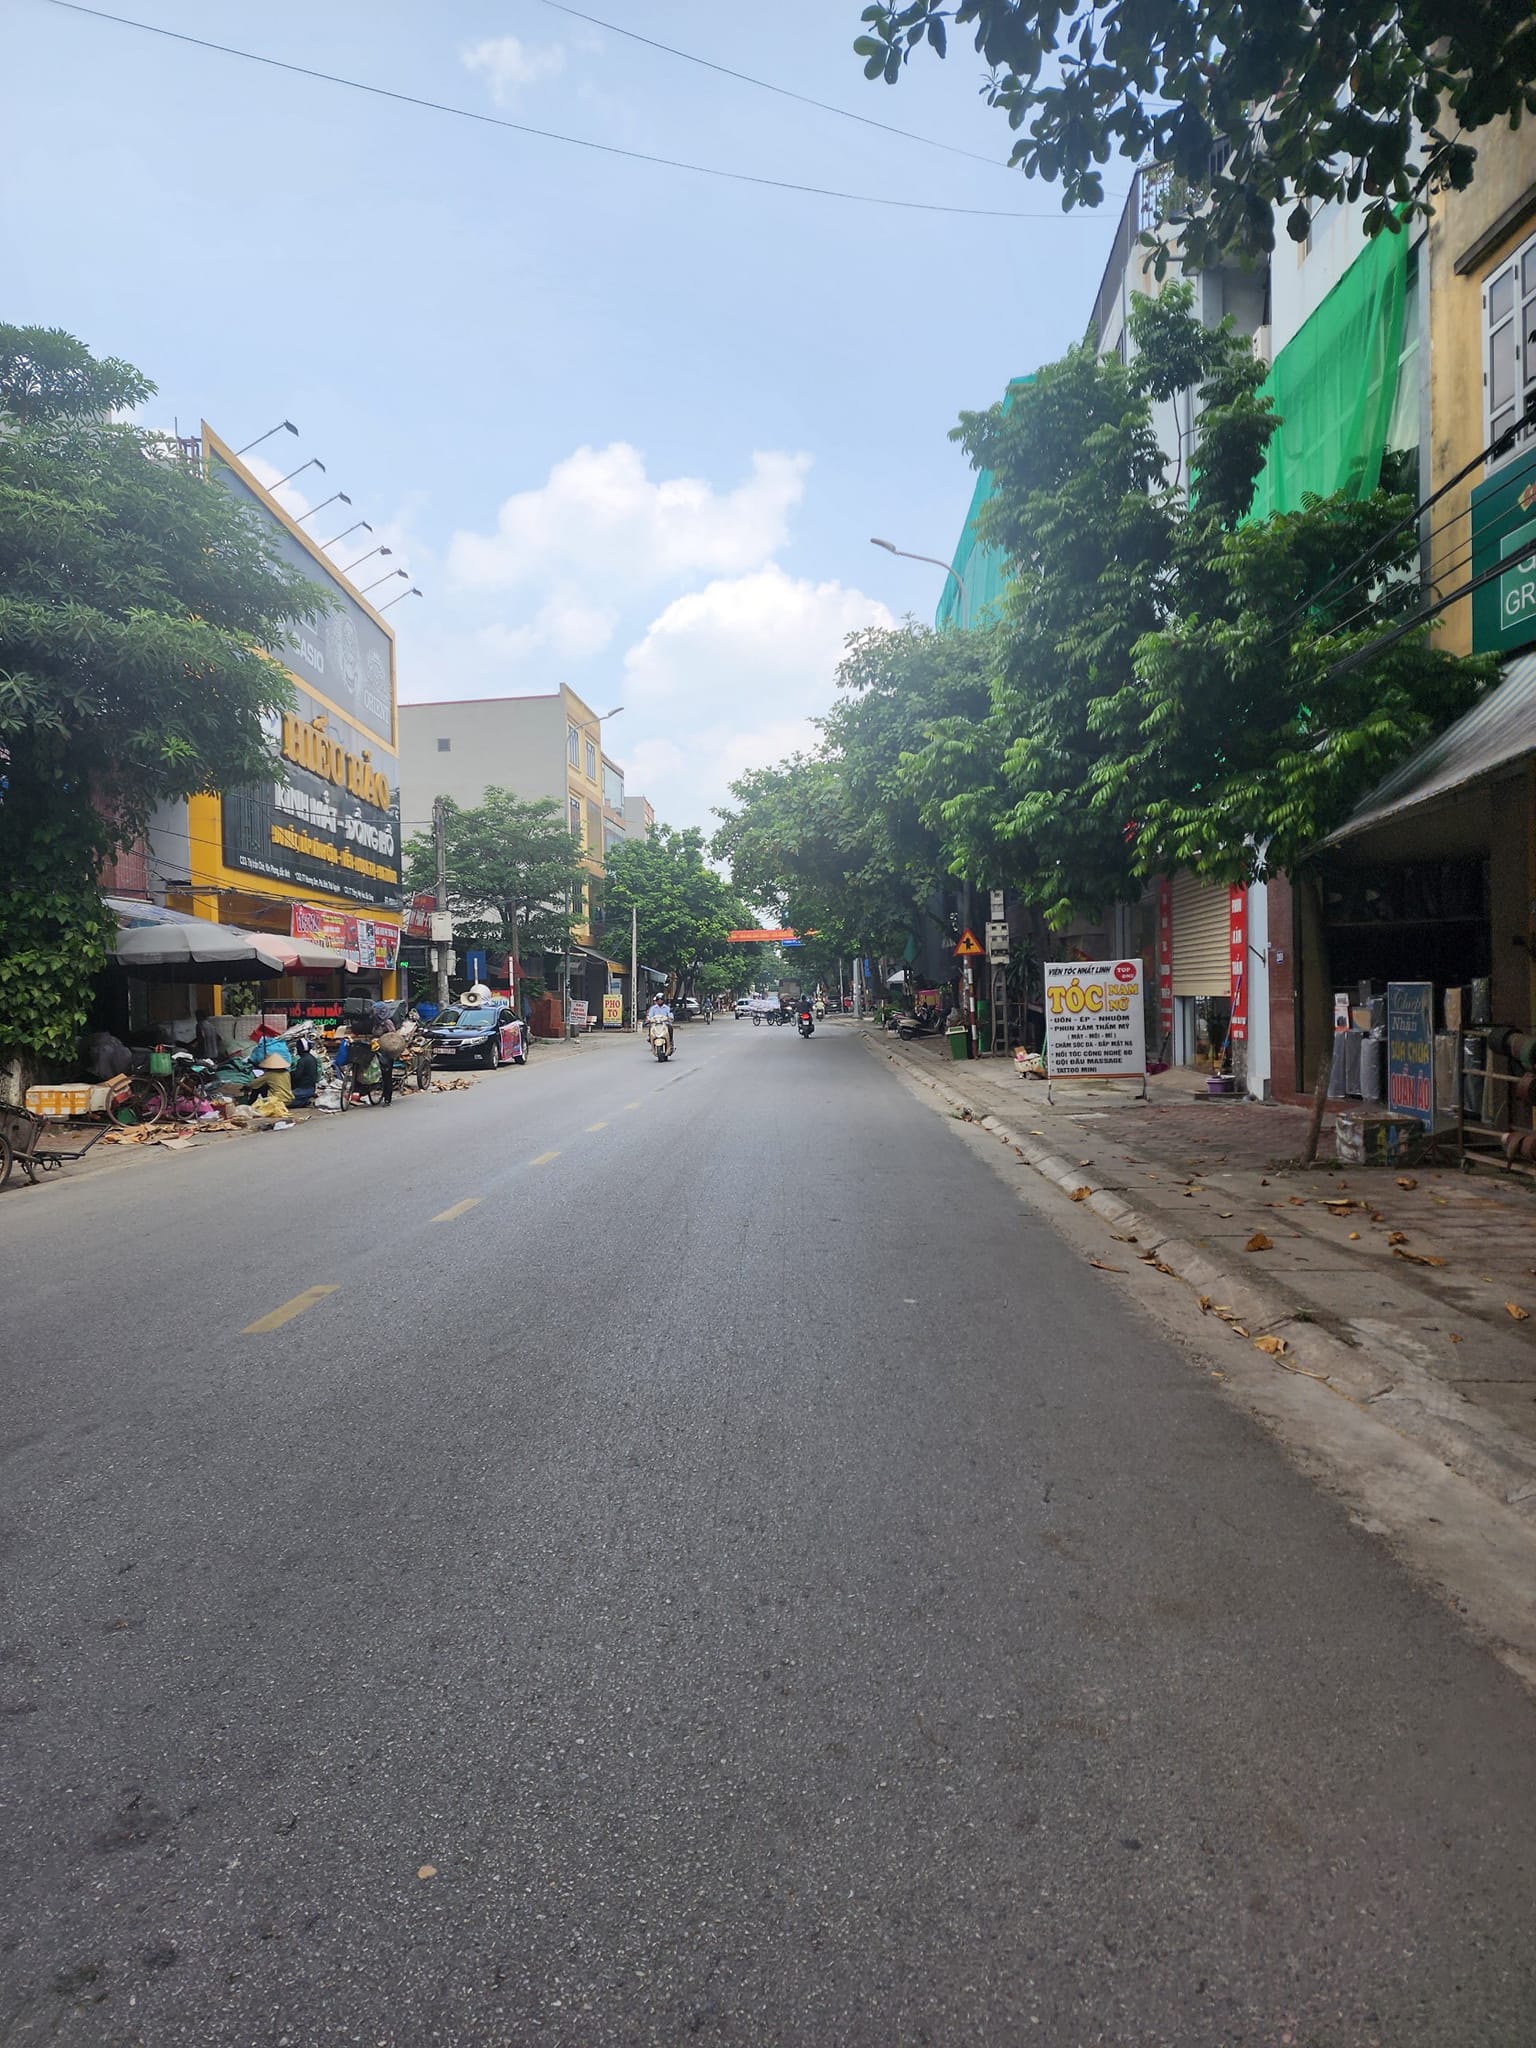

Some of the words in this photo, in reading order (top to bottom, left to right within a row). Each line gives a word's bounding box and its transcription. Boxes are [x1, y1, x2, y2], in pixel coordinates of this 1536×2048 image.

[344, 807, 378, 850] ĐỒNG
[379, 823, 394, 857] HỒ
[1047, 977, 1103, 1014] TÓC
[1108, 983, 1138, 996] NAM
[605, 1000, 620, 1008] PHO
[1108, 996, 1129, 1012] NỮ
